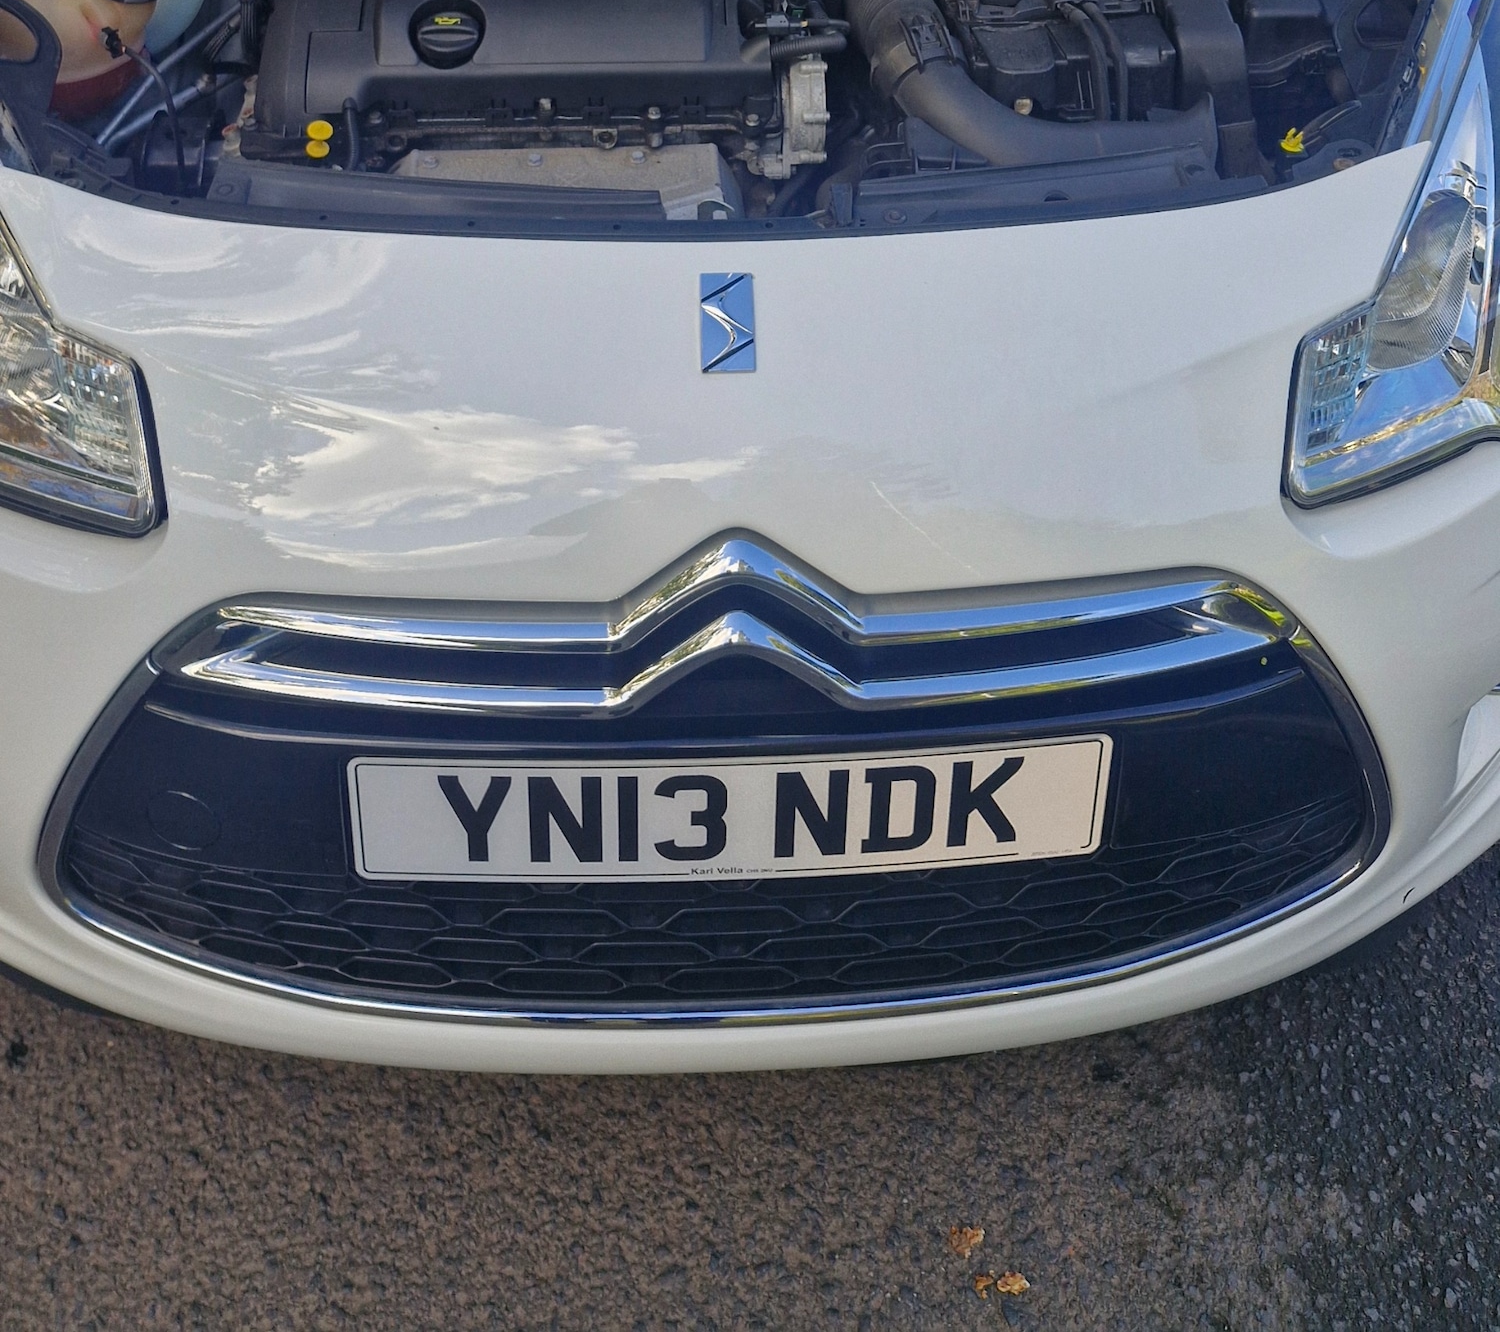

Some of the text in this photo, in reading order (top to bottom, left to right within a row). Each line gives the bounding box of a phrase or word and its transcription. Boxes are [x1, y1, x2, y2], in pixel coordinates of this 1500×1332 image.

[438, 757, 1024, 862] YN13 NDK
[691, 867, 713, 875] Karl
